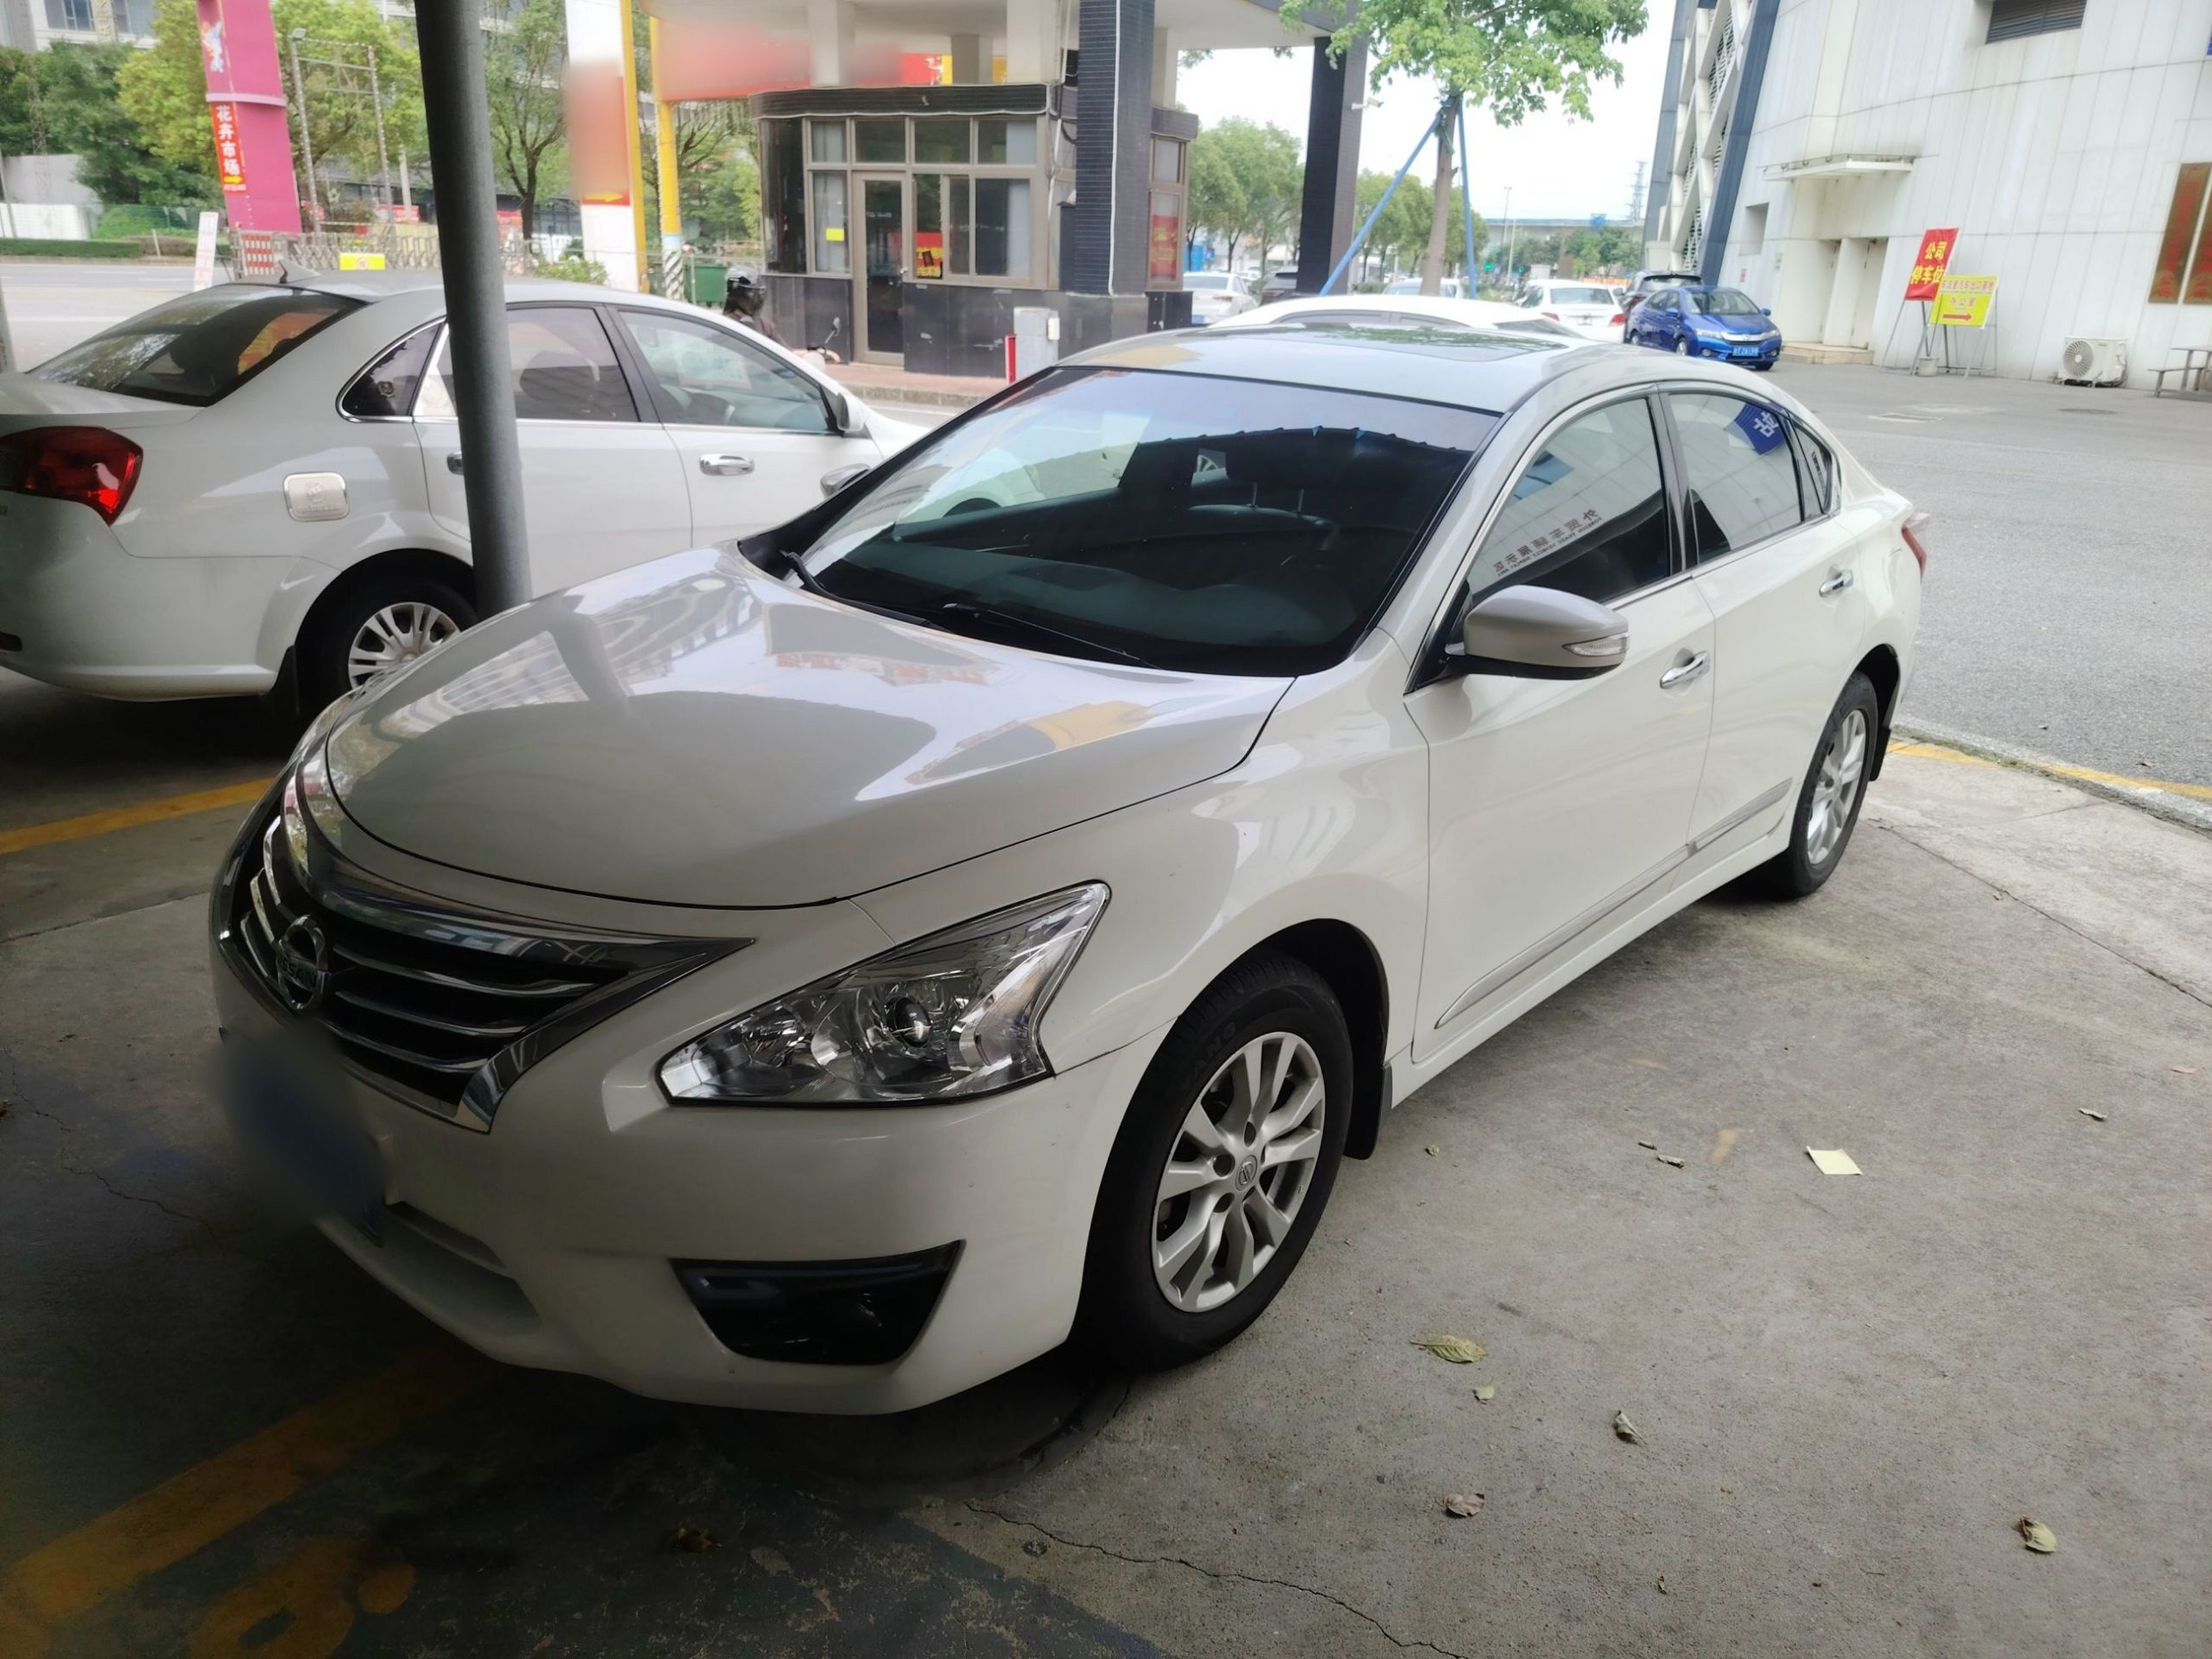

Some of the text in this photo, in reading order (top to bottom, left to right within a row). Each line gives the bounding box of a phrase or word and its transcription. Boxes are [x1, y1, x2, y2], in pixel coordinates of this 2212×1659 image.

[215, 104, 241, 175] 花卉市场
[1925, 240, 1948, 260] 公司
[1910, 264, 1944, 285] 停车位
